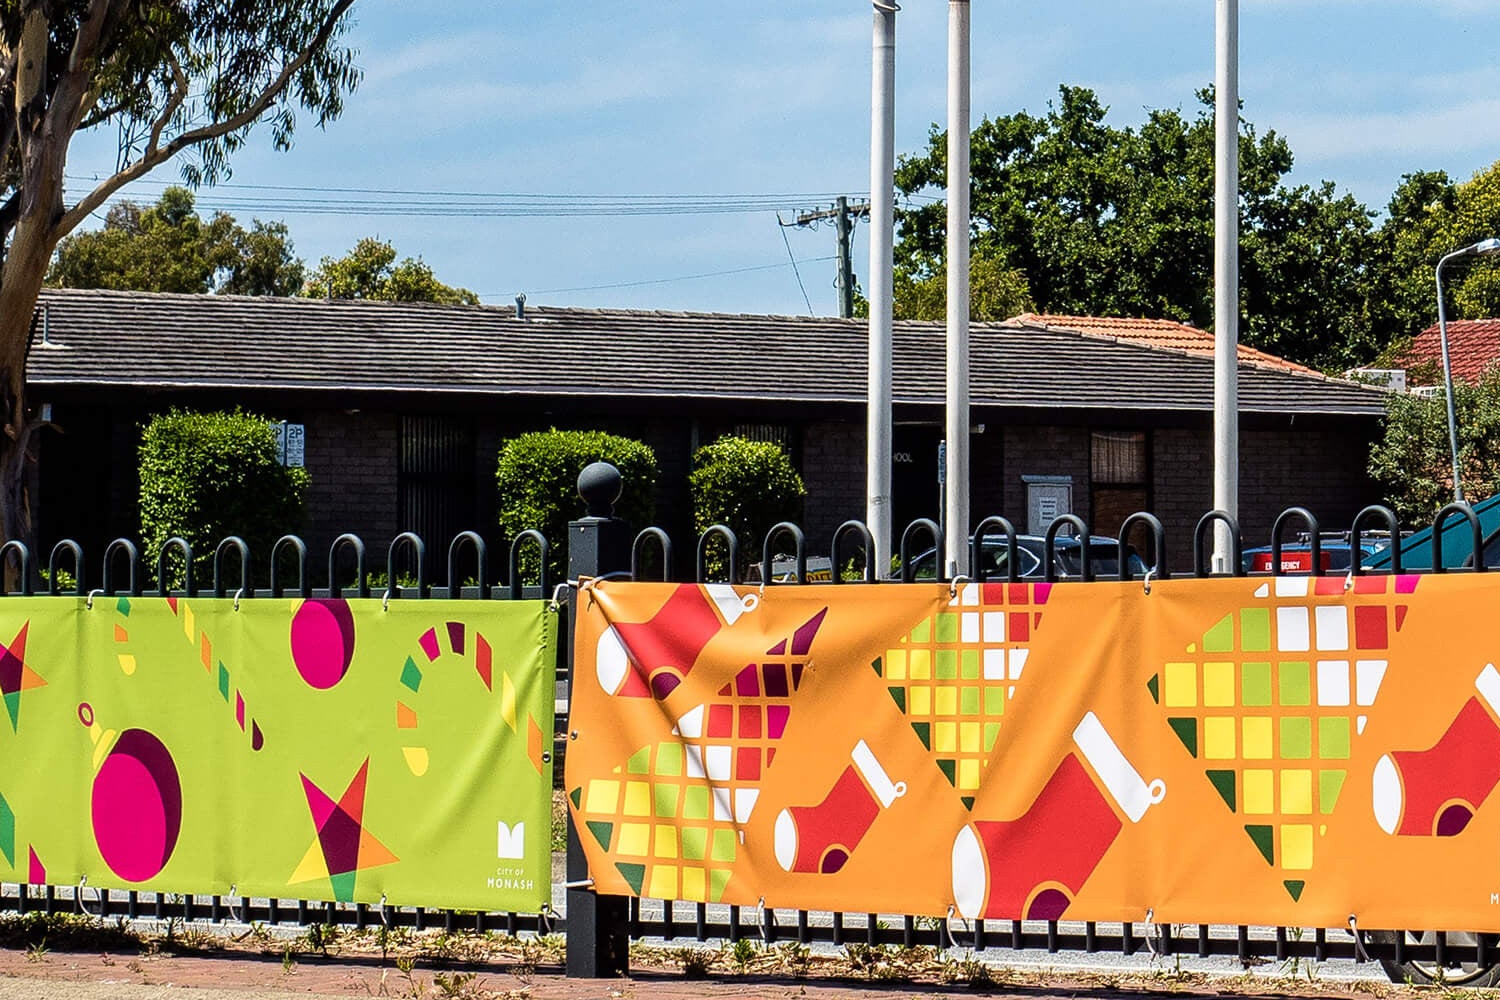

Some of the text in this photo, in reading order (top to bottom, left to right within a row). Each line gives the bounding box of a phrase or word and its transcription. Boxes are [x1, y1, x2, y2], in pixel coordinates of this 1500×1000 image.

[288, 428, 303, 439] 2P
[497, 867, 512, 876] CITY
[487, 878, 534, 890] MONASH
